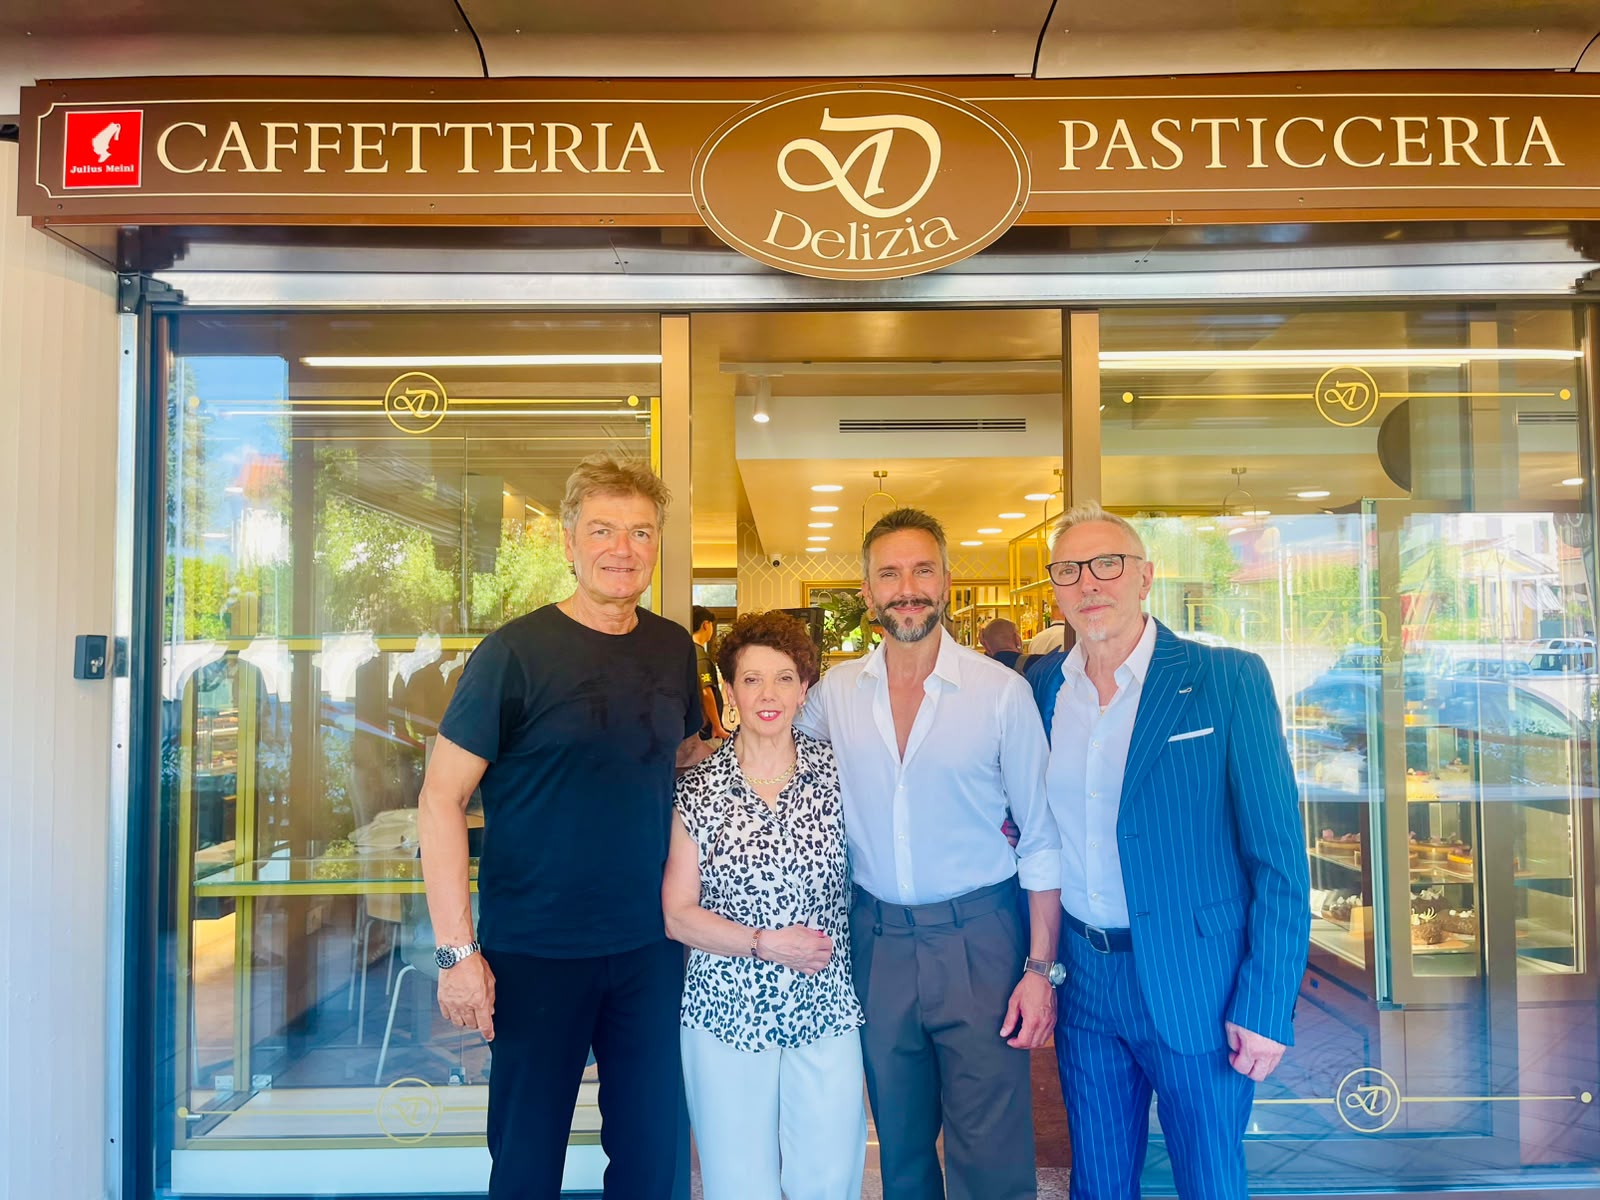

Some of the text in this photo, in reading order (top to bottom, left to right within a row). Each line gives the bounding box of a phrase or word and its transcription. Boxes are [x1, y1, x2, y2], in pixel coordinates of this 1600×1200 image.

[69, 164, 135, 174] Julius Meinl
[156, 121, 665, 174] CAFFETTERIA
[1058, 116, 1566, 171] PASTICCERIA
[762, 208, 960, 261] Delizia
